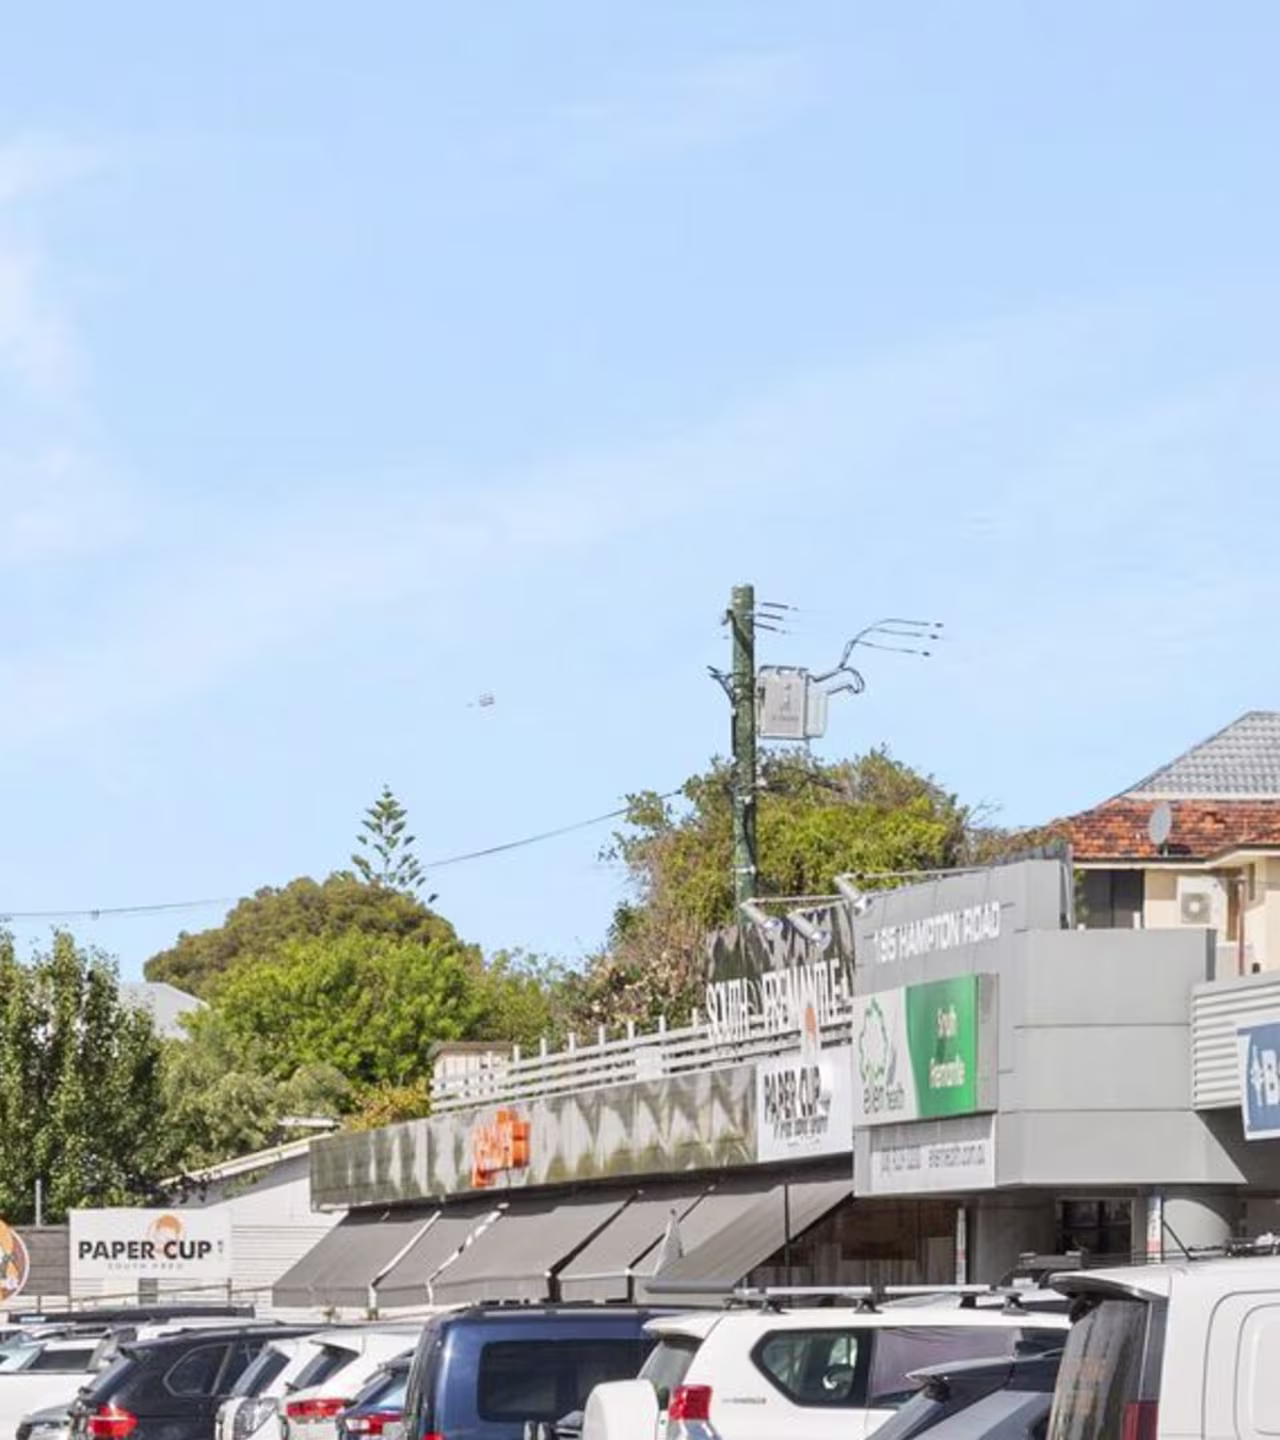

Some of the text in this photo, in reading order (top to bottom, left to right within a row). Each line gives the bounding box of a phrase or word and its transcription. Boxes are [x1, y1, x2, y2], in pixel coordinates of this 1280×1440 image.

[899, 911, 960, 959] HAMPTON
[963, 901, 1000, 943] ROAD
[78, 1240, 155, 1260] PAPER
[163, 1240, 213, 1260] CUP
